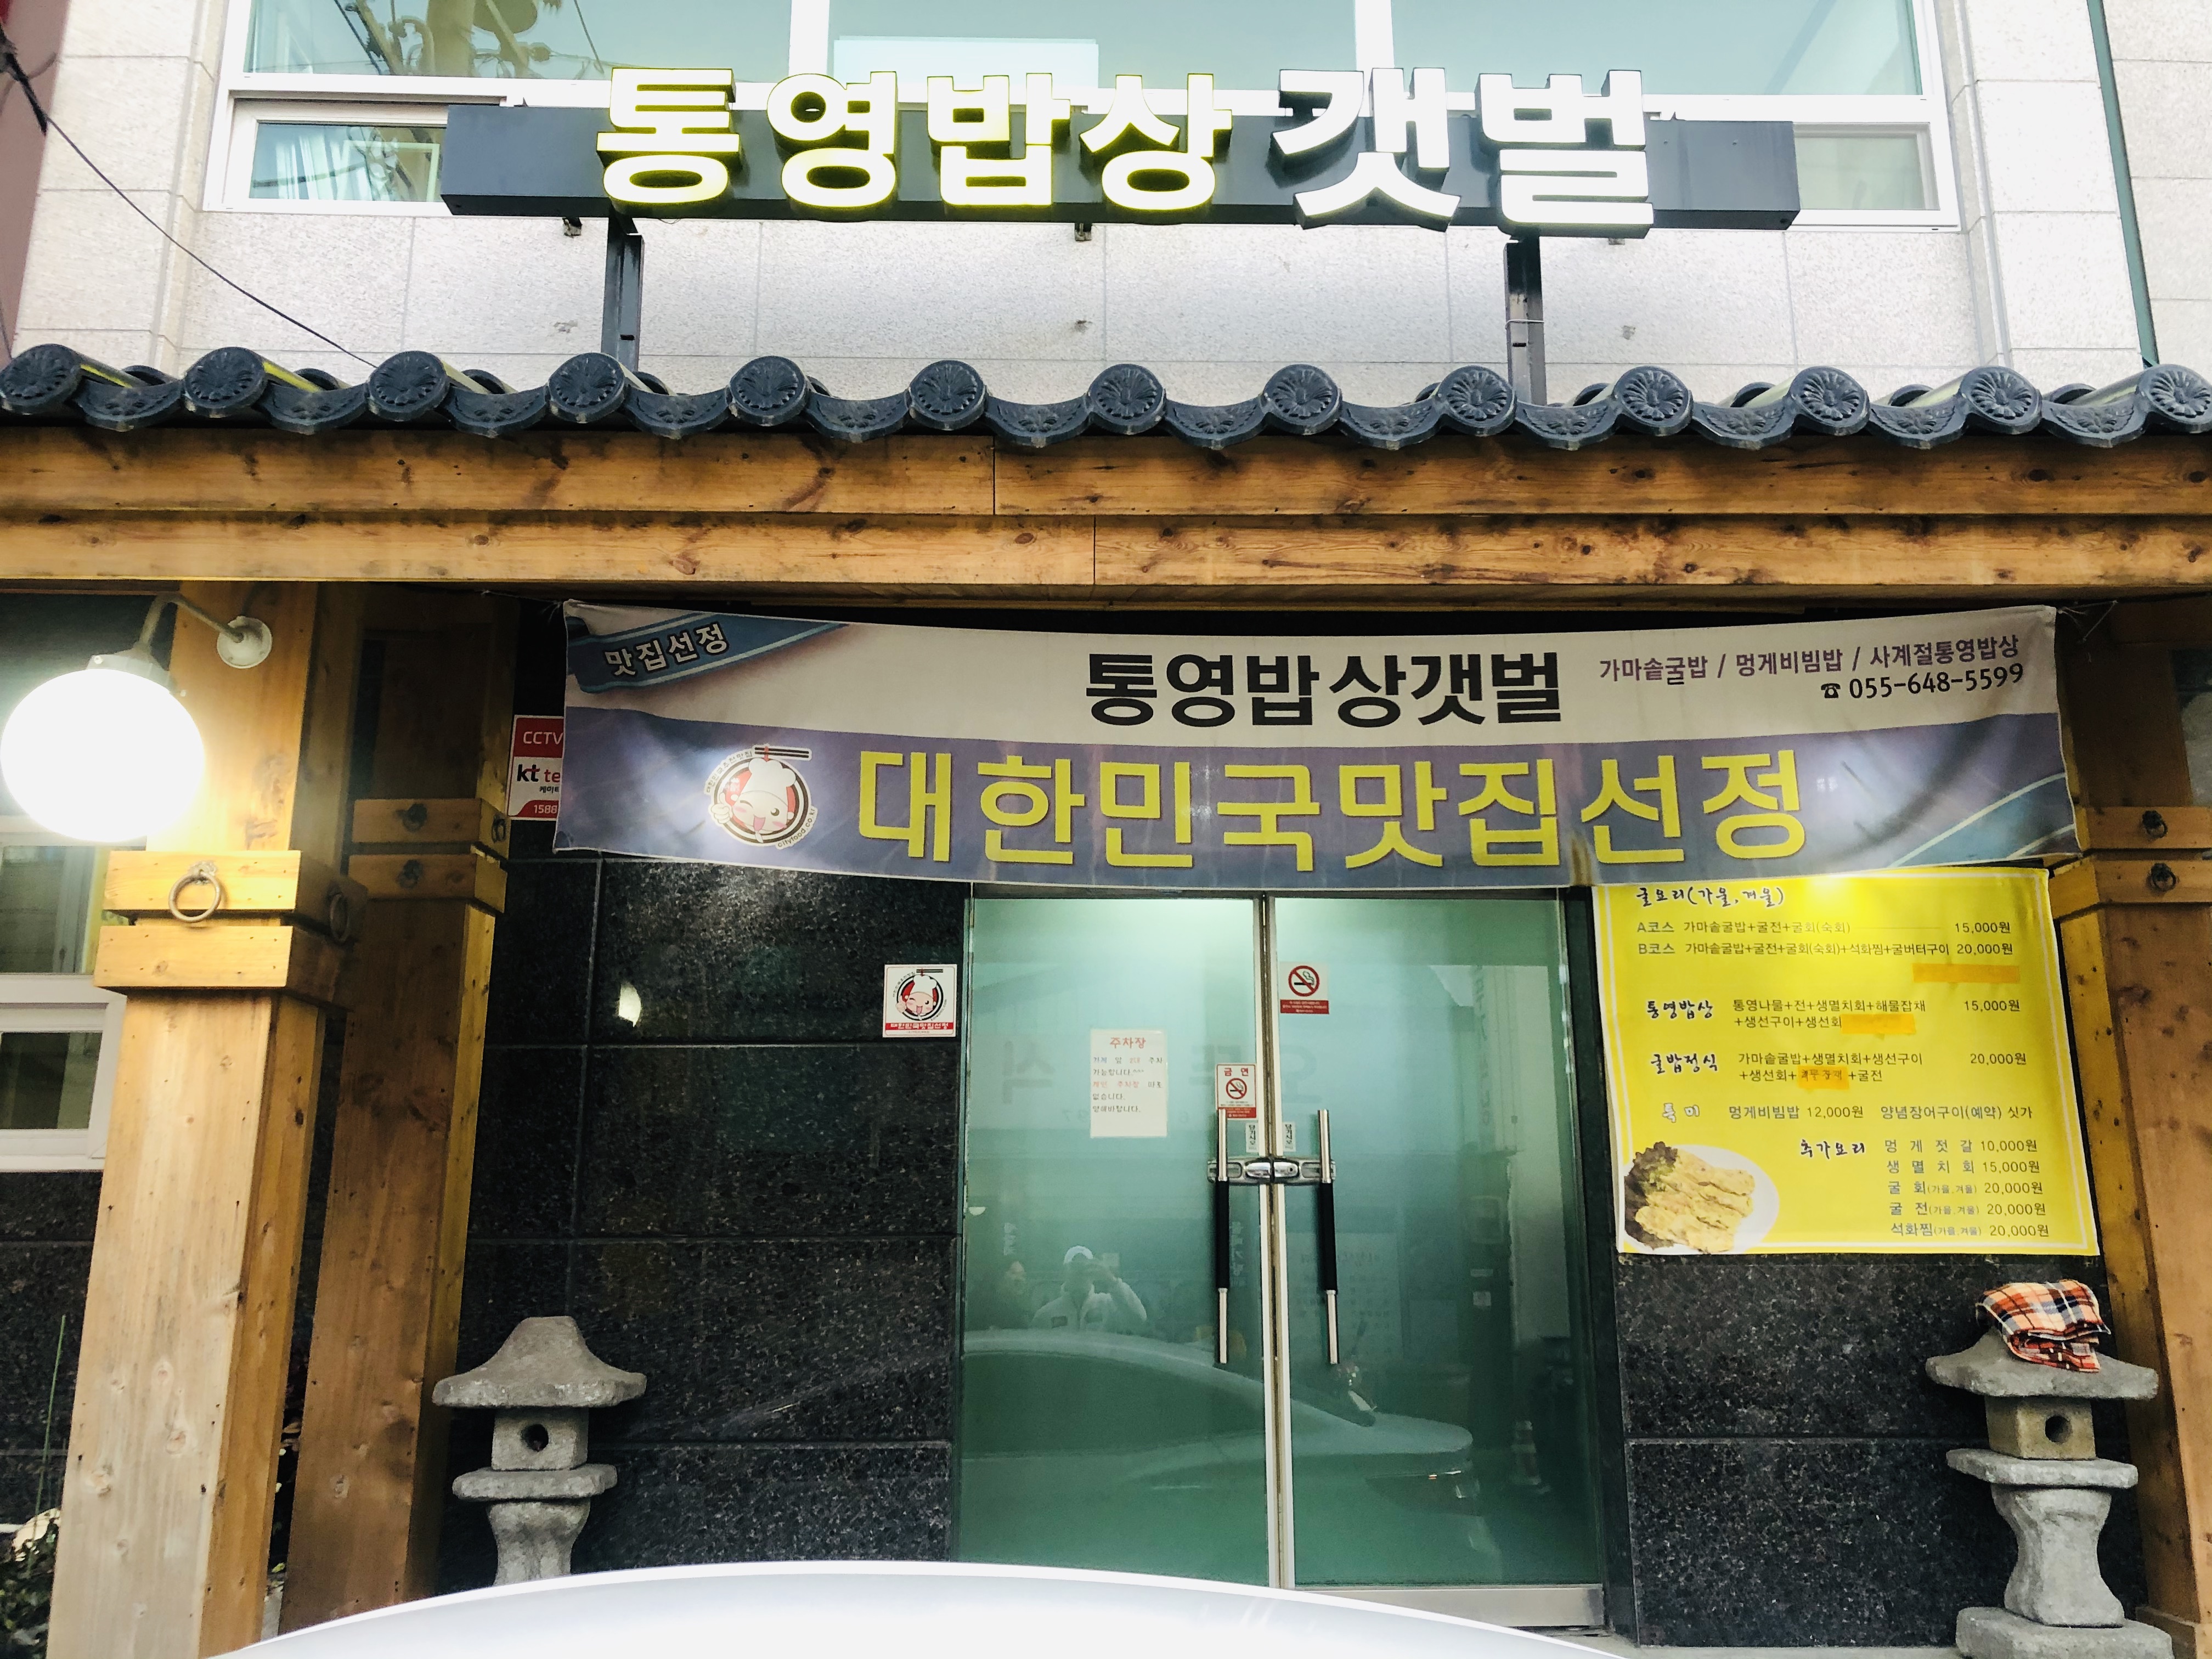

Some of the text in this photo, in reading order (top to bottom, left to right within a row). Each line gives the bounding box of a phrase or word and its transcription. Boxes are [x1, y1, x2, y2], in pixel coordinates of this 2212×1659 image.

[604, 623, 728, 676] 맛집선정
[1600, 656, 1708, 685] 가마솥굴밥
[1736, 648, 1843, 677] 멍게비빔밥
[1870, 634, 2019, 668] 사계절통영밥상
[1849, 662, 2024, 699] 055-648-5599
[1086, 651, 1562, 729] 통영밥상갯벌
[523, 730, 563, 745] CCTV
[517, 764, 540, 783] kt
[859, 749, 1805, 872] 대한민국맛집선정
[777, 808, 816, 848] cityfood.co.kr
[1637, 922, 1675, 934] A코스
[1955, 921, 2011, 934] 15,000원
[1638, 943, 1676, 955] B코스
[1956, 943, 2013, 956] 20,000원
[1646, 1000, 1714, 1019] 통영밥상
[1964, 998, 2021, 1012] 15,000원
[1110, 1037, 1146, 1049] 주차장
[1650, 1053, 1718, 1075] 굴밥정식
[1970, 1052, 2027, 1066] 20,000원
[1729, 1104, 1799, 1119] 멍게비빔밥
[1807, 1105, 1864, 1119] 12,000원
[1881, 1105, 2002, 1120] 양념장어구이(예약)
[2008, 1106, 2033, 1120] 싯가
[1801, 1139, 1865, 1159] 추가요리
[1980, 1139, 2038, 1153] 10,000원
[1983, 1161, 2040, 1173] 15,000원
[1984, 1182, 2043, 1195] 20,000원
[1987, 1203, 2046, 1216] 20,000원
[1989, 1224, 2049, 1237] 20,000원
